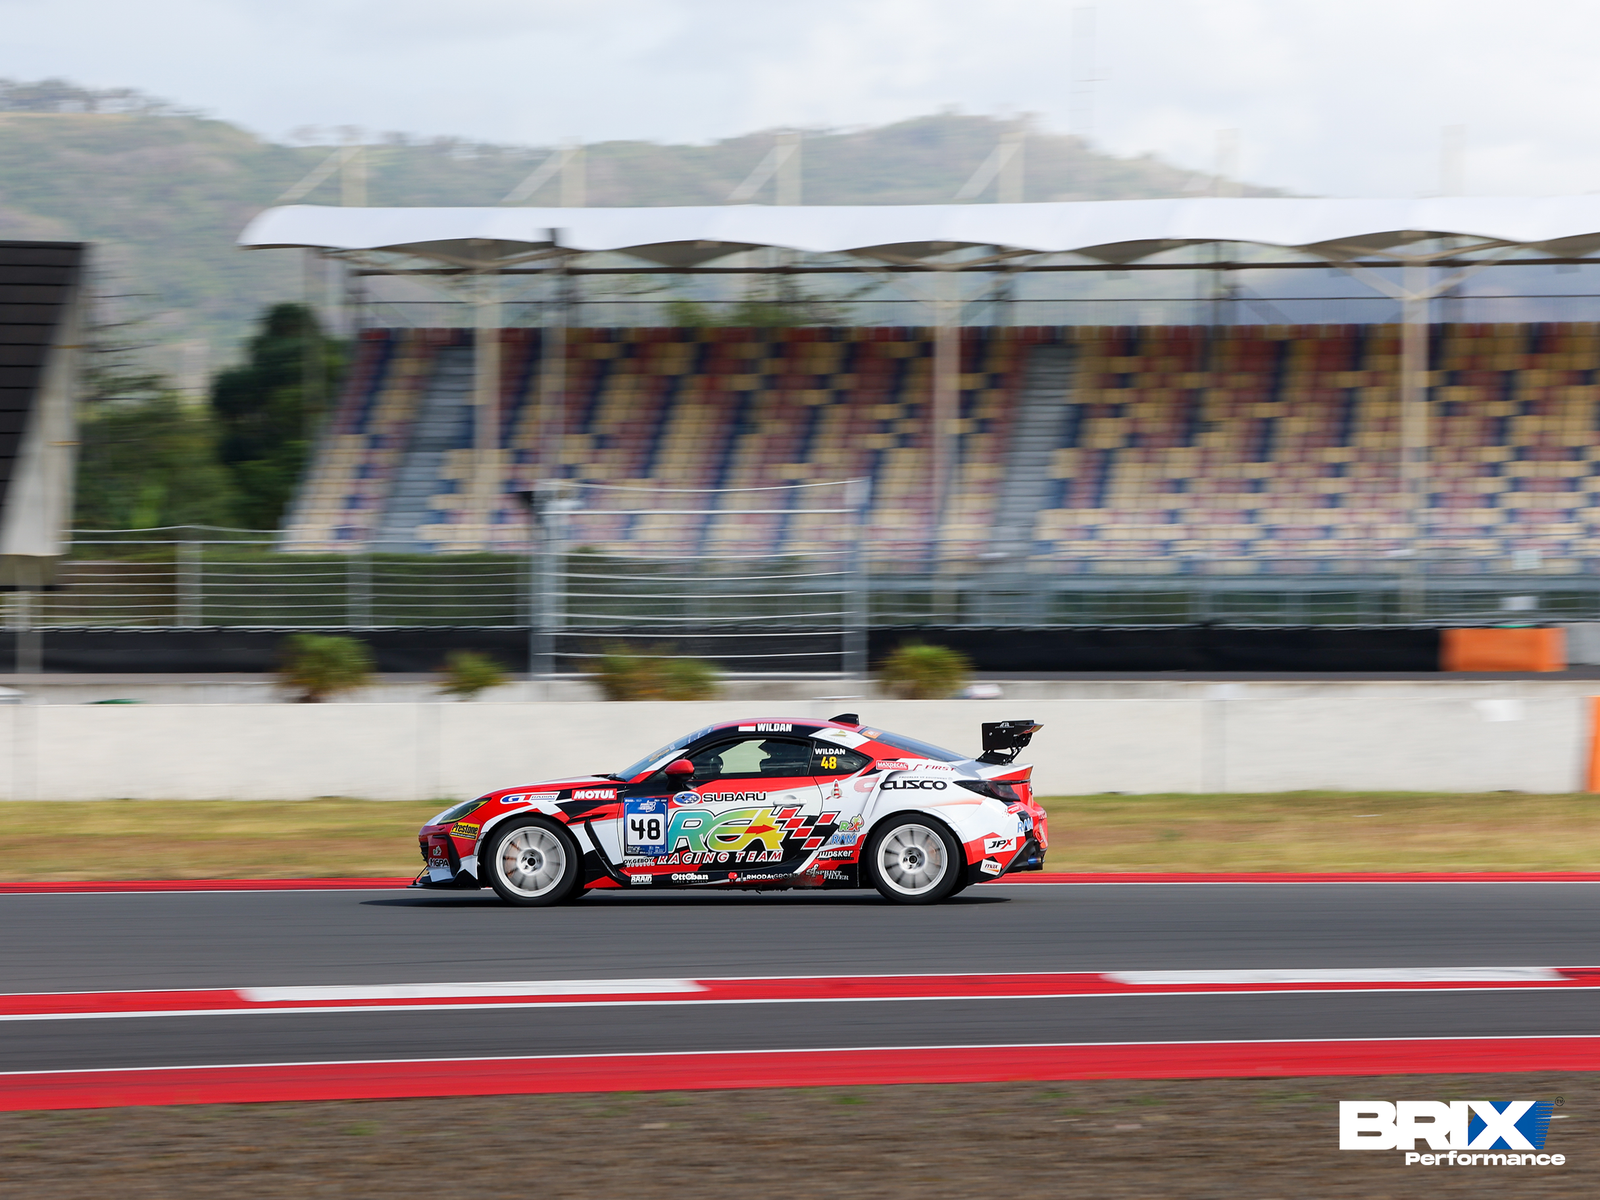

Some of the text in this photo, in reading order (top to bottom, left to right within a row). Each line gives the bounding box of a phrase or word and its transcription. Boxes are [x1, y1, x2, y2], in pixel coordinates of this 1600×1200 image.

[757, 723, 792, 732] WILDAN
[820, 756, 837, 770] 48
[924, 764, 956, 772] FIRST
[879, 779, 948, 791] CUSCO
[573, 789, 616, 799] MOTUL
[703, 792, 767, 802] SUBARU
[451, 822, 479, 835] Prestone
[630, 818, 661, 840] 48
[830, 833, 857, 844] RAM
[988, 838, 1014, 850] JPX
[657, 850, 784, 865] RACING TEAM
